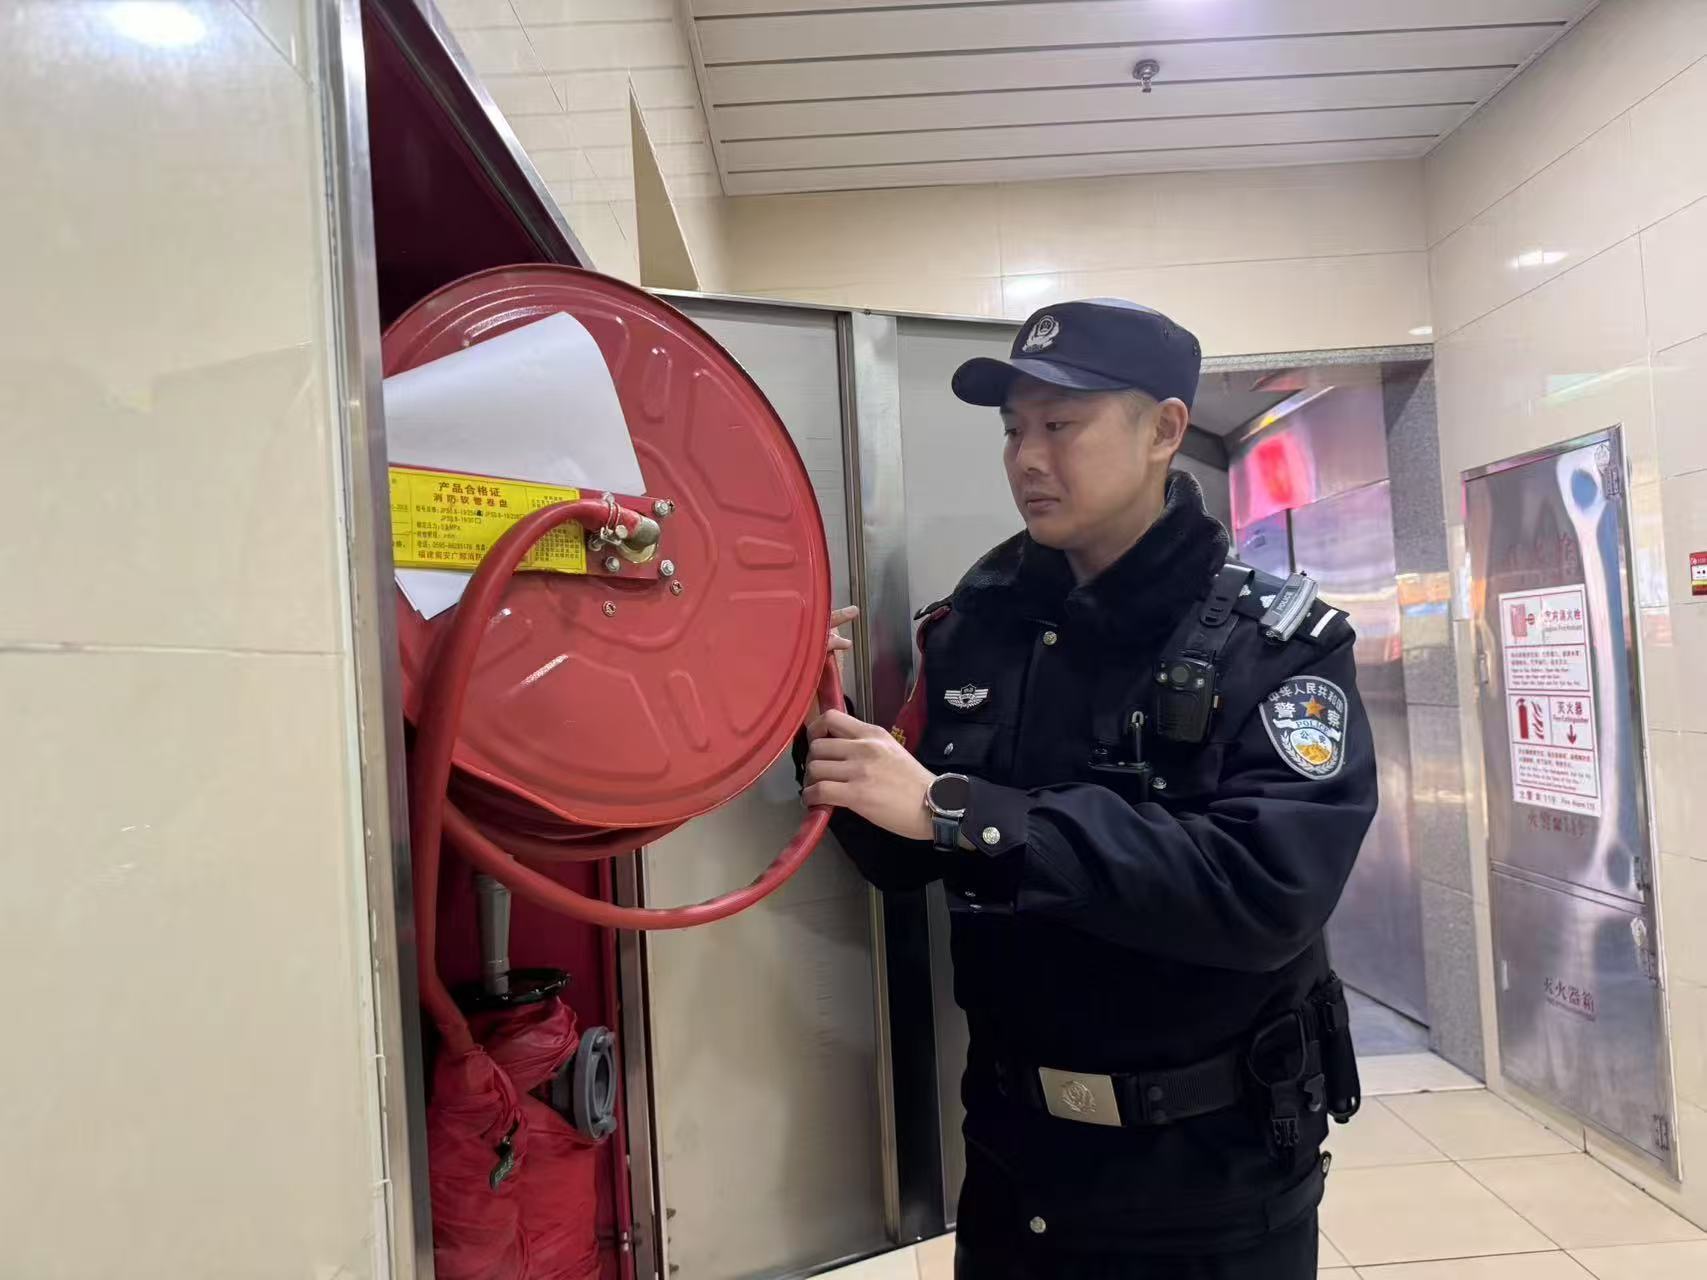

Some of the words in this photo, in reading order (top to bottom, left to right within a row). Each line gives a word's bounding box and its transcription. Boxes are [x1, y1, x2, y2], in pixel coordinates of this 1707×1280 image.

[438, 481, 502, 497] 产品合格证
[433, 492, 508, 509] 消防软管卷盘
[1268, 682, 1344, 713] 中华人民共和国
[1274, 702, 1297, 719] 警
[1327, 709, 1341, 729] 察
[1556, 701, 1583, 716] 灭火器
[1295, 720, 1329, 734] POLICE
